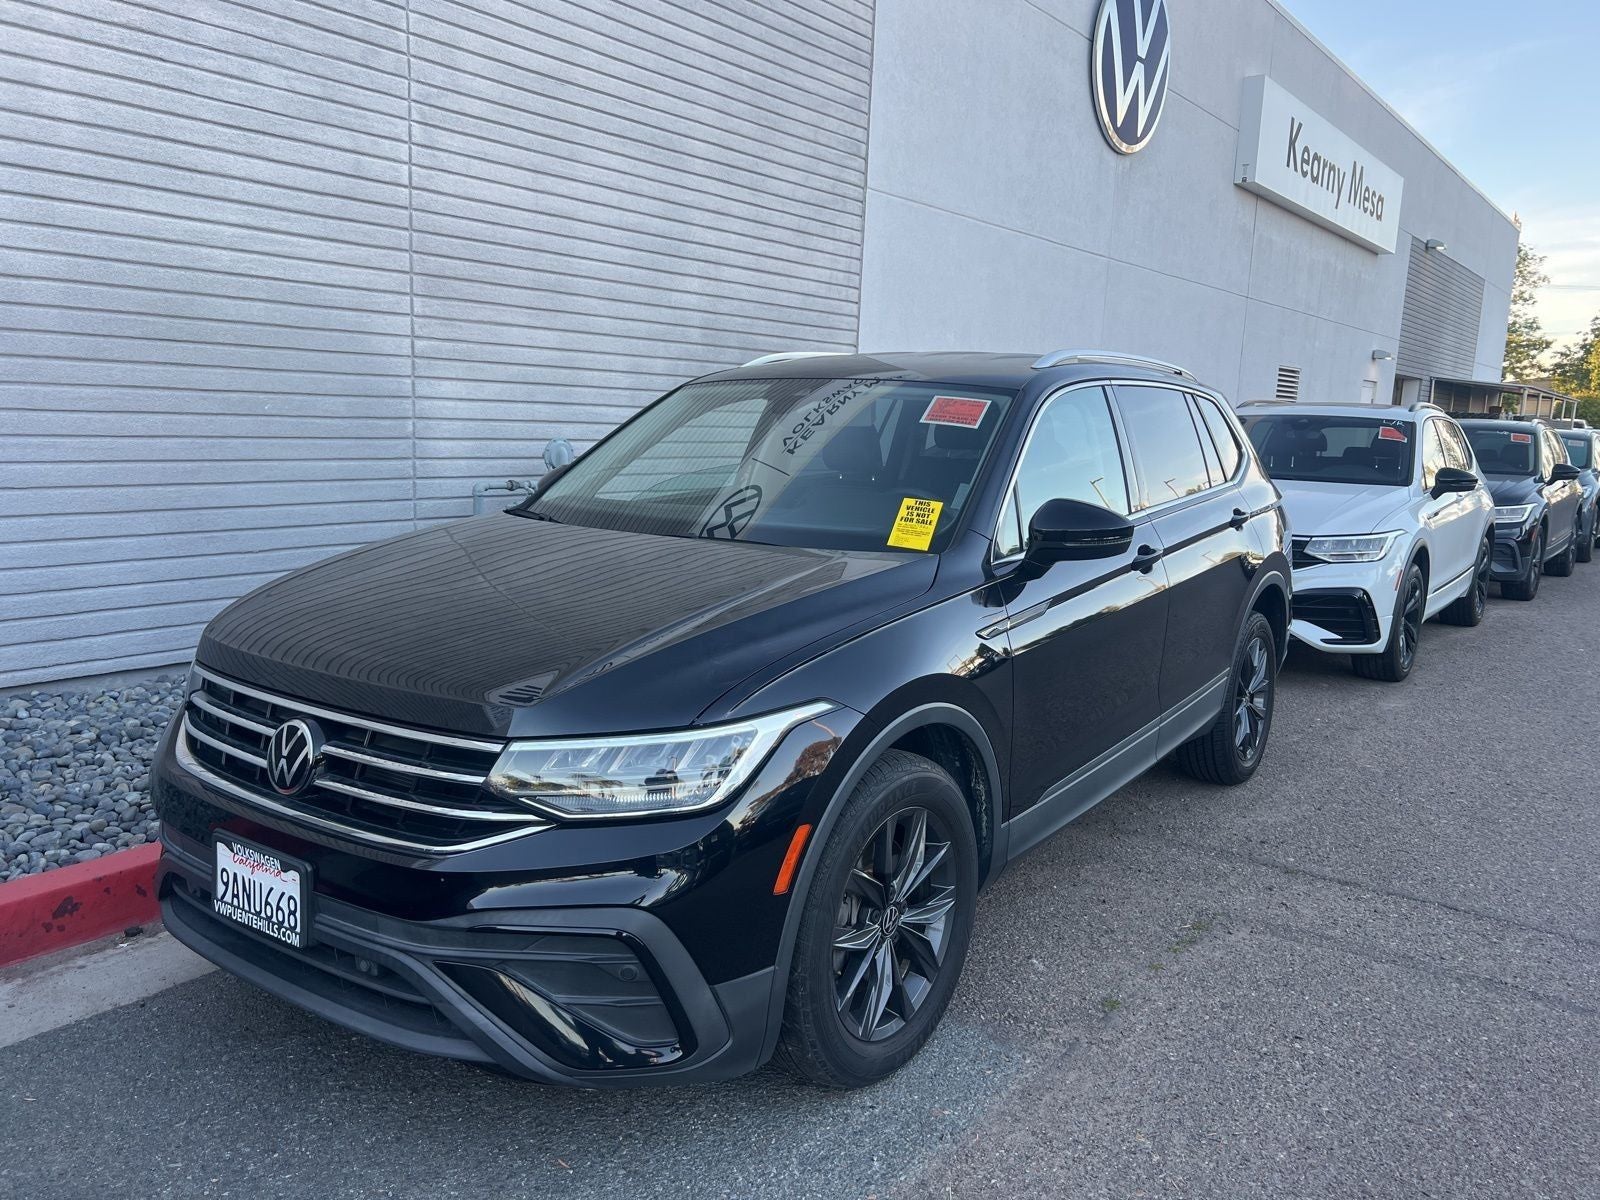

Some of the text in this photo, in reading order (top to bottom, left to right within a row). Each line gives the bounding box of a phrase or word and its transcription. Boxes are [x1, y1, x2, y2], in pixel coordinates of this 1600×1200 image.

[1286, 116, 1385, 222] Kearny Mesa
[906, 505, 935, 514] VEHICLE
[231, 842, 281, 871] VOLKSWAGEN
[214, 899, 300, 948] VWPUENTEHILLS.COM
[220, 867, 298, 932] 9ANU668
